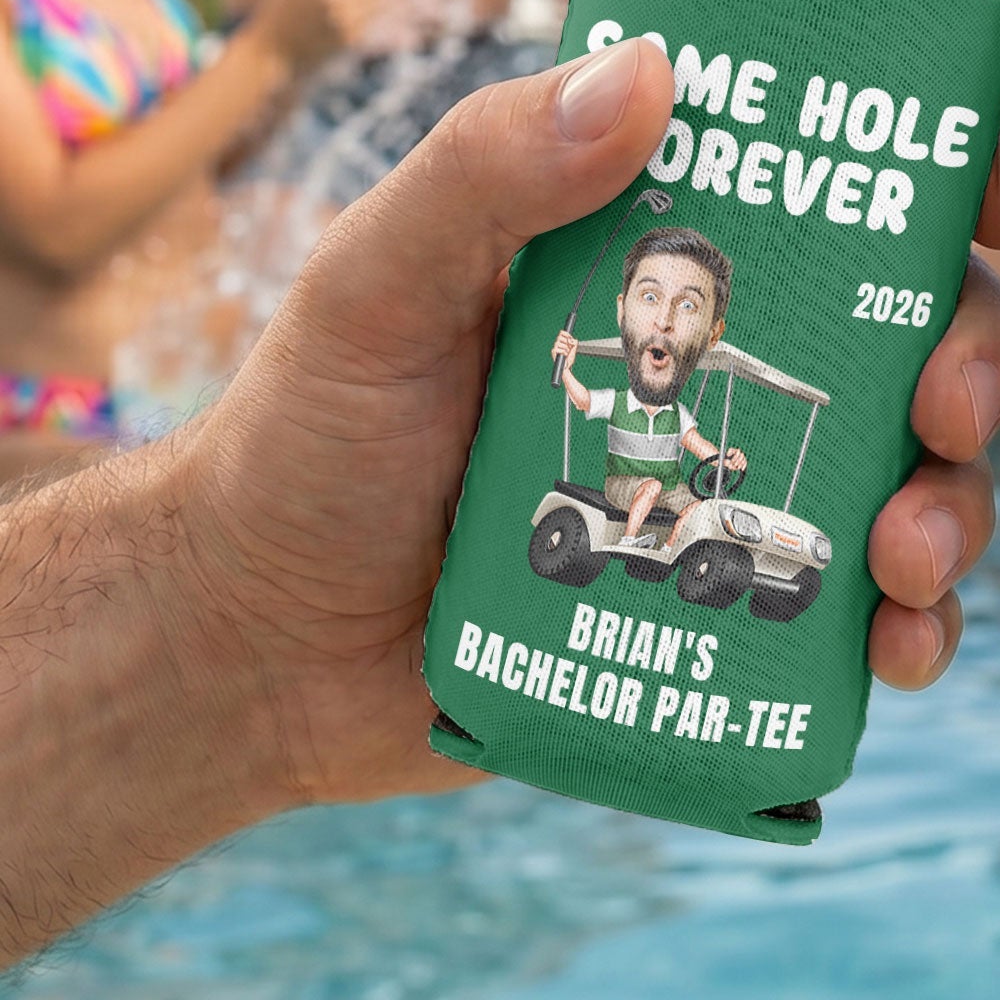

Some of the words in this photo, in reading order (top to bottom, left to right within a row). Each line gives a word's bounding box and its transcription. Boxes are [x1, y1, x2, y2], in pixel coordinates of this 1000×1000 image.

[587, 20, 778, 125] SME
[799, 76, 980, 168] HOLE
[646, 118, 915, 235] OREVER
[852, 283, 933, 328] 2026
[454, 620, 644, 727] BACHELOR
[650, 686, 812, 750] PAR-TEE
[567, 602, 719, 682] BRIAN'S
